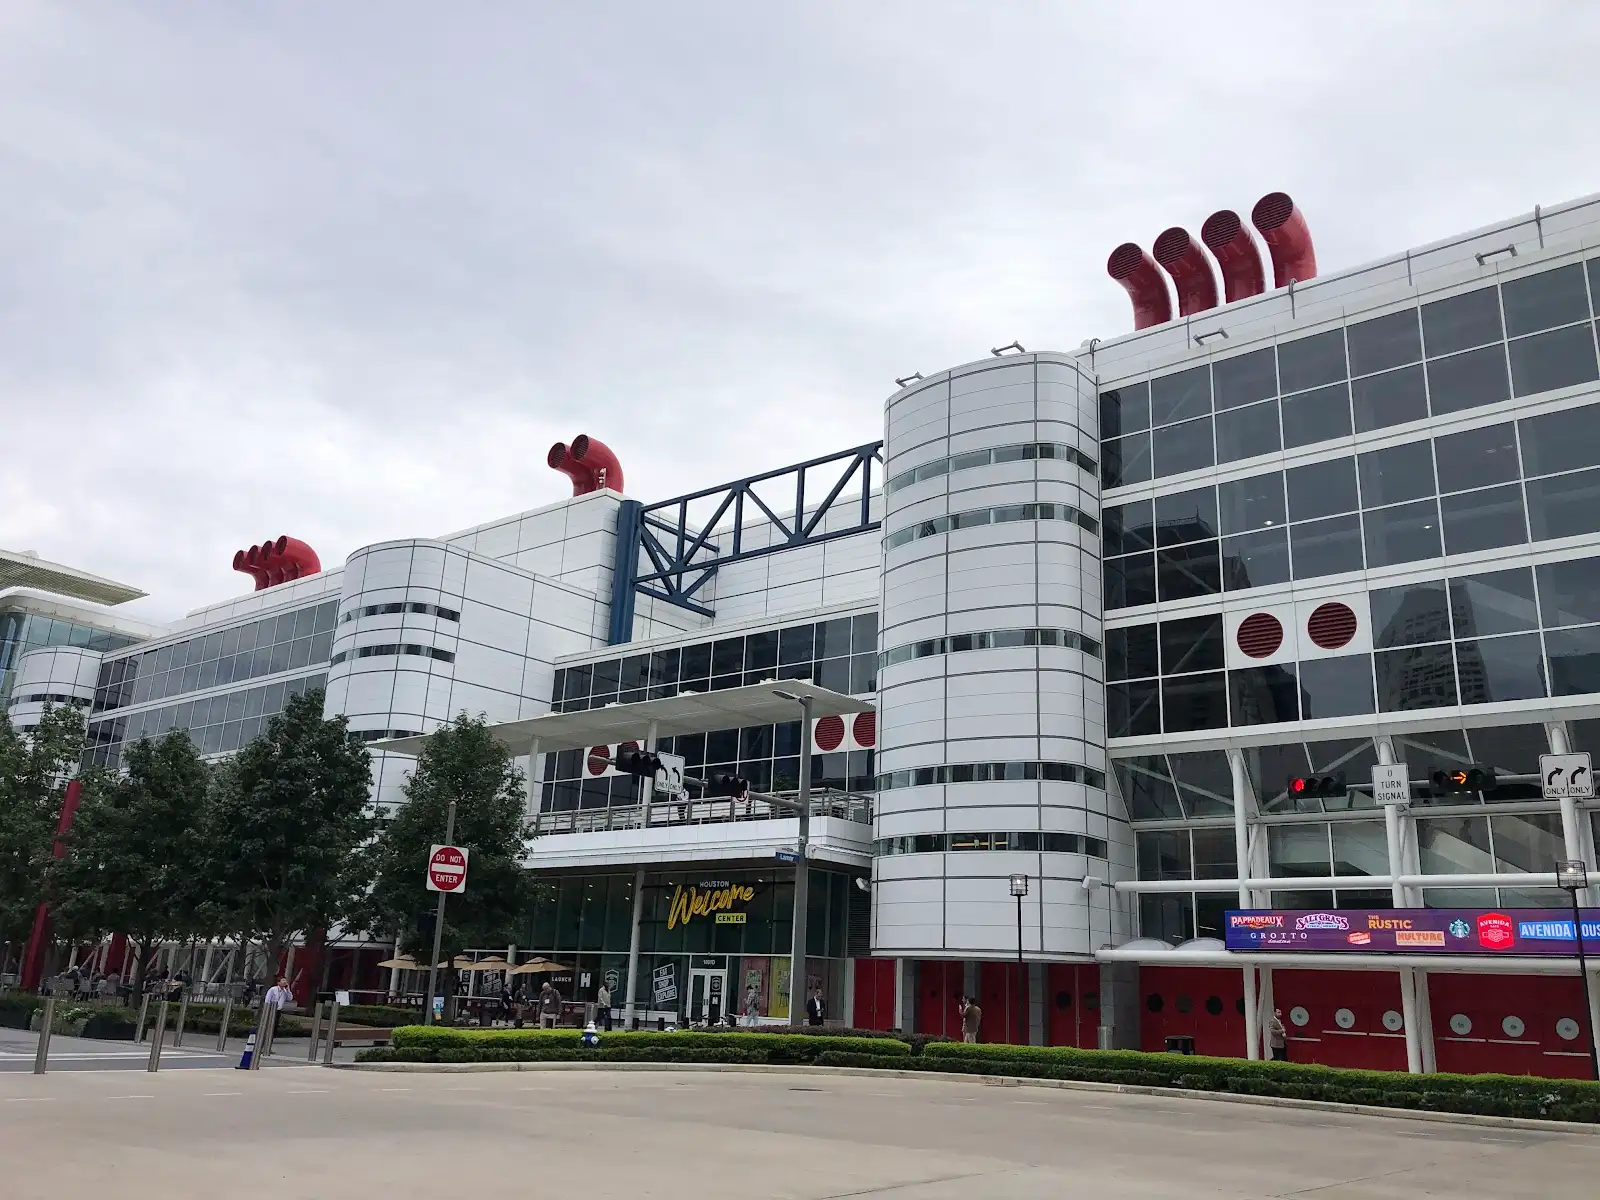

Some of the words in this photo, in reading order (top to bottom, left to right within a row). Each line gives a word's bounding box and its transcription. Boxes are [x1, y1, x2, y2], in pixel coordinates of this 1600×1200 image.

[1387, 769, 1393, 777] U
[656, 780, 669, 790] ONLY
[669, 782, 682, 792] ONLY
[1380, 780, 1402, 790] TURN
[1569, 785, 1591, 794] ONLY
[1546, 786, 1567, 795] ONLY
[1377, 791, 1407, 801] SIGNAL
[435, 854, 446, 862] DO
[449, 855, 462, 864] NOT
[435, 874, 458, 884] ENTER
[667, 884, 756, 930] Welcome
[1231, 916, 1284, 928] PAPPADEAUX
[1295, 913, 1349, 930] SALTGRASS
[1368, 919, 1412, 929] RUSTIC
[1479, 919, 1510, 928] AVENIDA
[1521, 923, 1572, 937] AVENIDA
[1250, 932, 1308, 940] GROTTO
[1397, 932, 1443, 942] KULTURE
[659, 967, 668, 977] EAT
